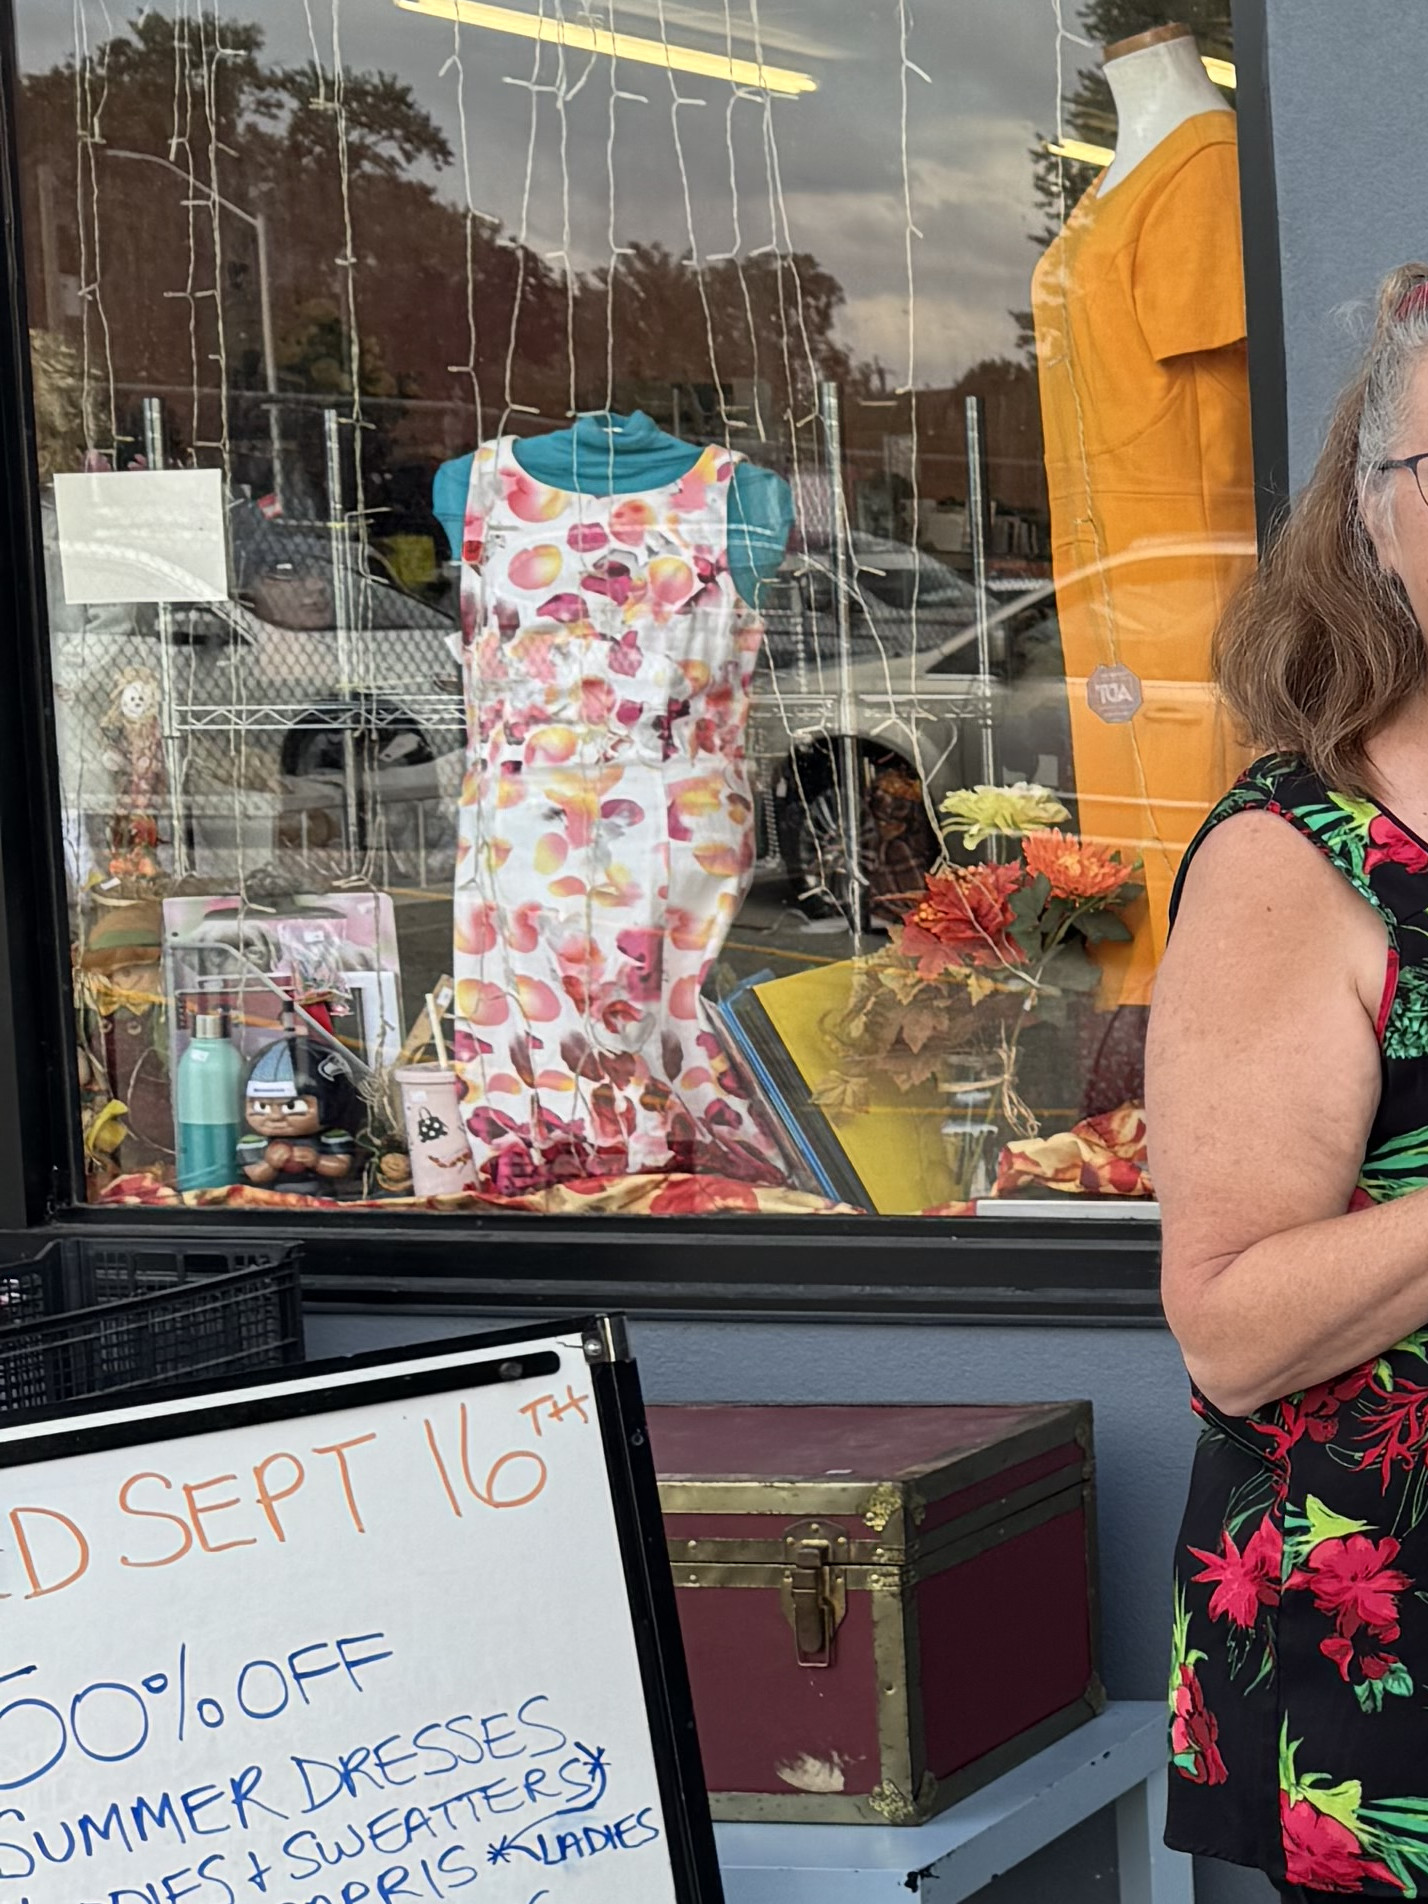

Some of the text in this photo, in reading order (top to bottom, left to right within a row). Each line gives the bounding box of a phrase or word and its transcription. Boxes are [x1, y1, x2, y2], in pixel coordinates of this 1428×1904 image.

[118, 1433, 377, 1567] SEPT
[237, 1632, 394, 1719] OFF
[0, 1695, 567, 1879] SUMMER DRESSES
[537, 1807, 660, 1865] LADIES
